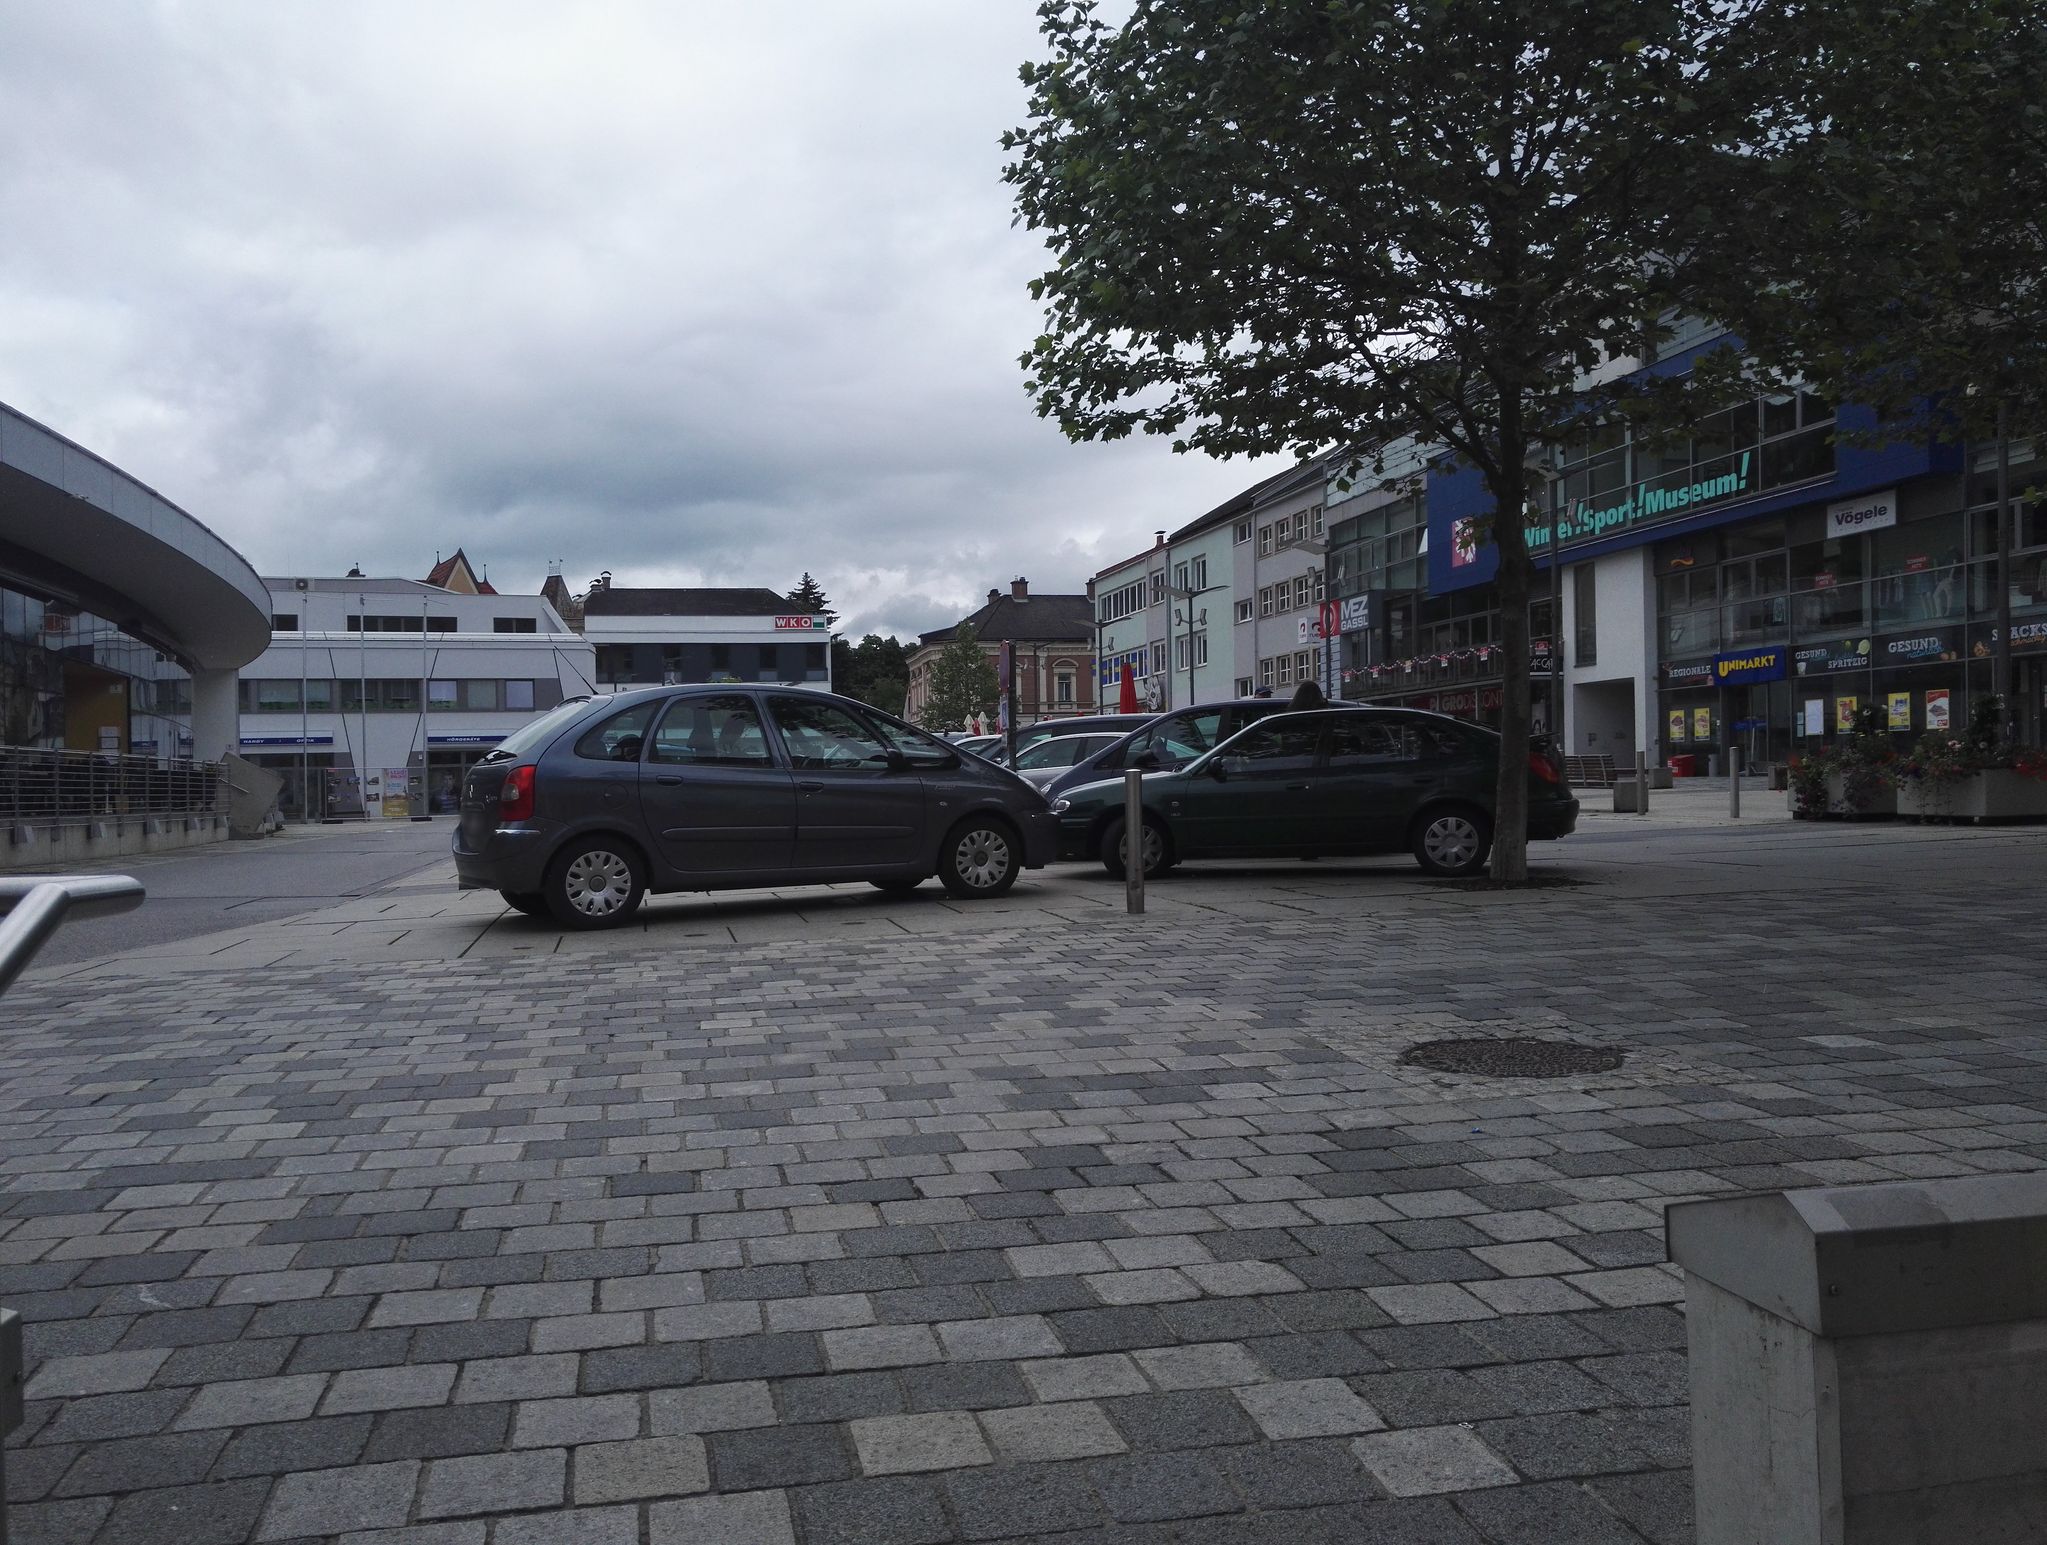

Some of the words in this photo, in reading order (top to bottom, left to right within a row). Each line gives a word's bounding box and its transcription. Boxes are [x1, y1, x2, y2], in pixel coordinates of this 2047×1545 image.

[1835, 505, 1888, 526] Vögele
[1341, 595, 1369, 620] MEZ
[776, 618, 811, 627] WKO
[1341, 615, 1369, 631] GASSL
[1888, 637, 1939, 653] GESUND
[1795, 648, 1828, 660] GESUND
[1718, 654, 1776, 678] UNIMARKT
[1828, 656, 1868, 669] SPRITZIG
